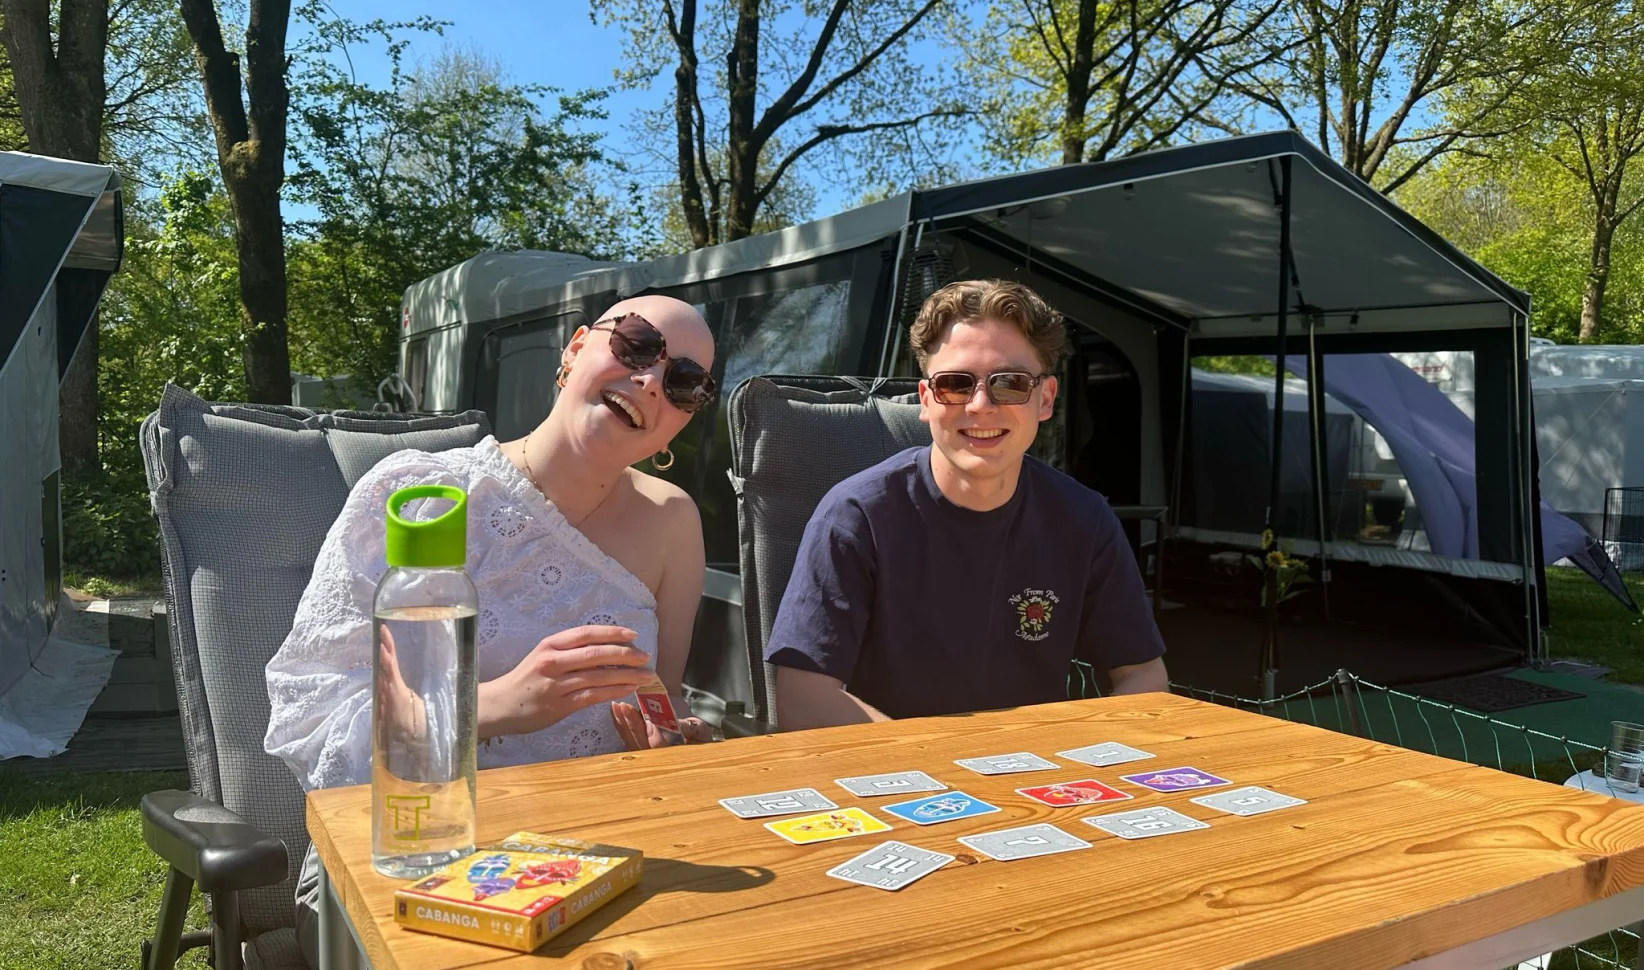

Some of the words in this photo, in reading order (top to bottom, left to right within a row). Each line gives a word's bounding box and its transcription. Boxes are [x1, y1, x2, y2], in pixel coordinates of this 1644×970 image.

[1024, 588, 1044, 596] From
[863, 852, 920, 875] 14
[571, 880, 612, 915] CABANGA
[415, 905, 480, 929] CABANGA
